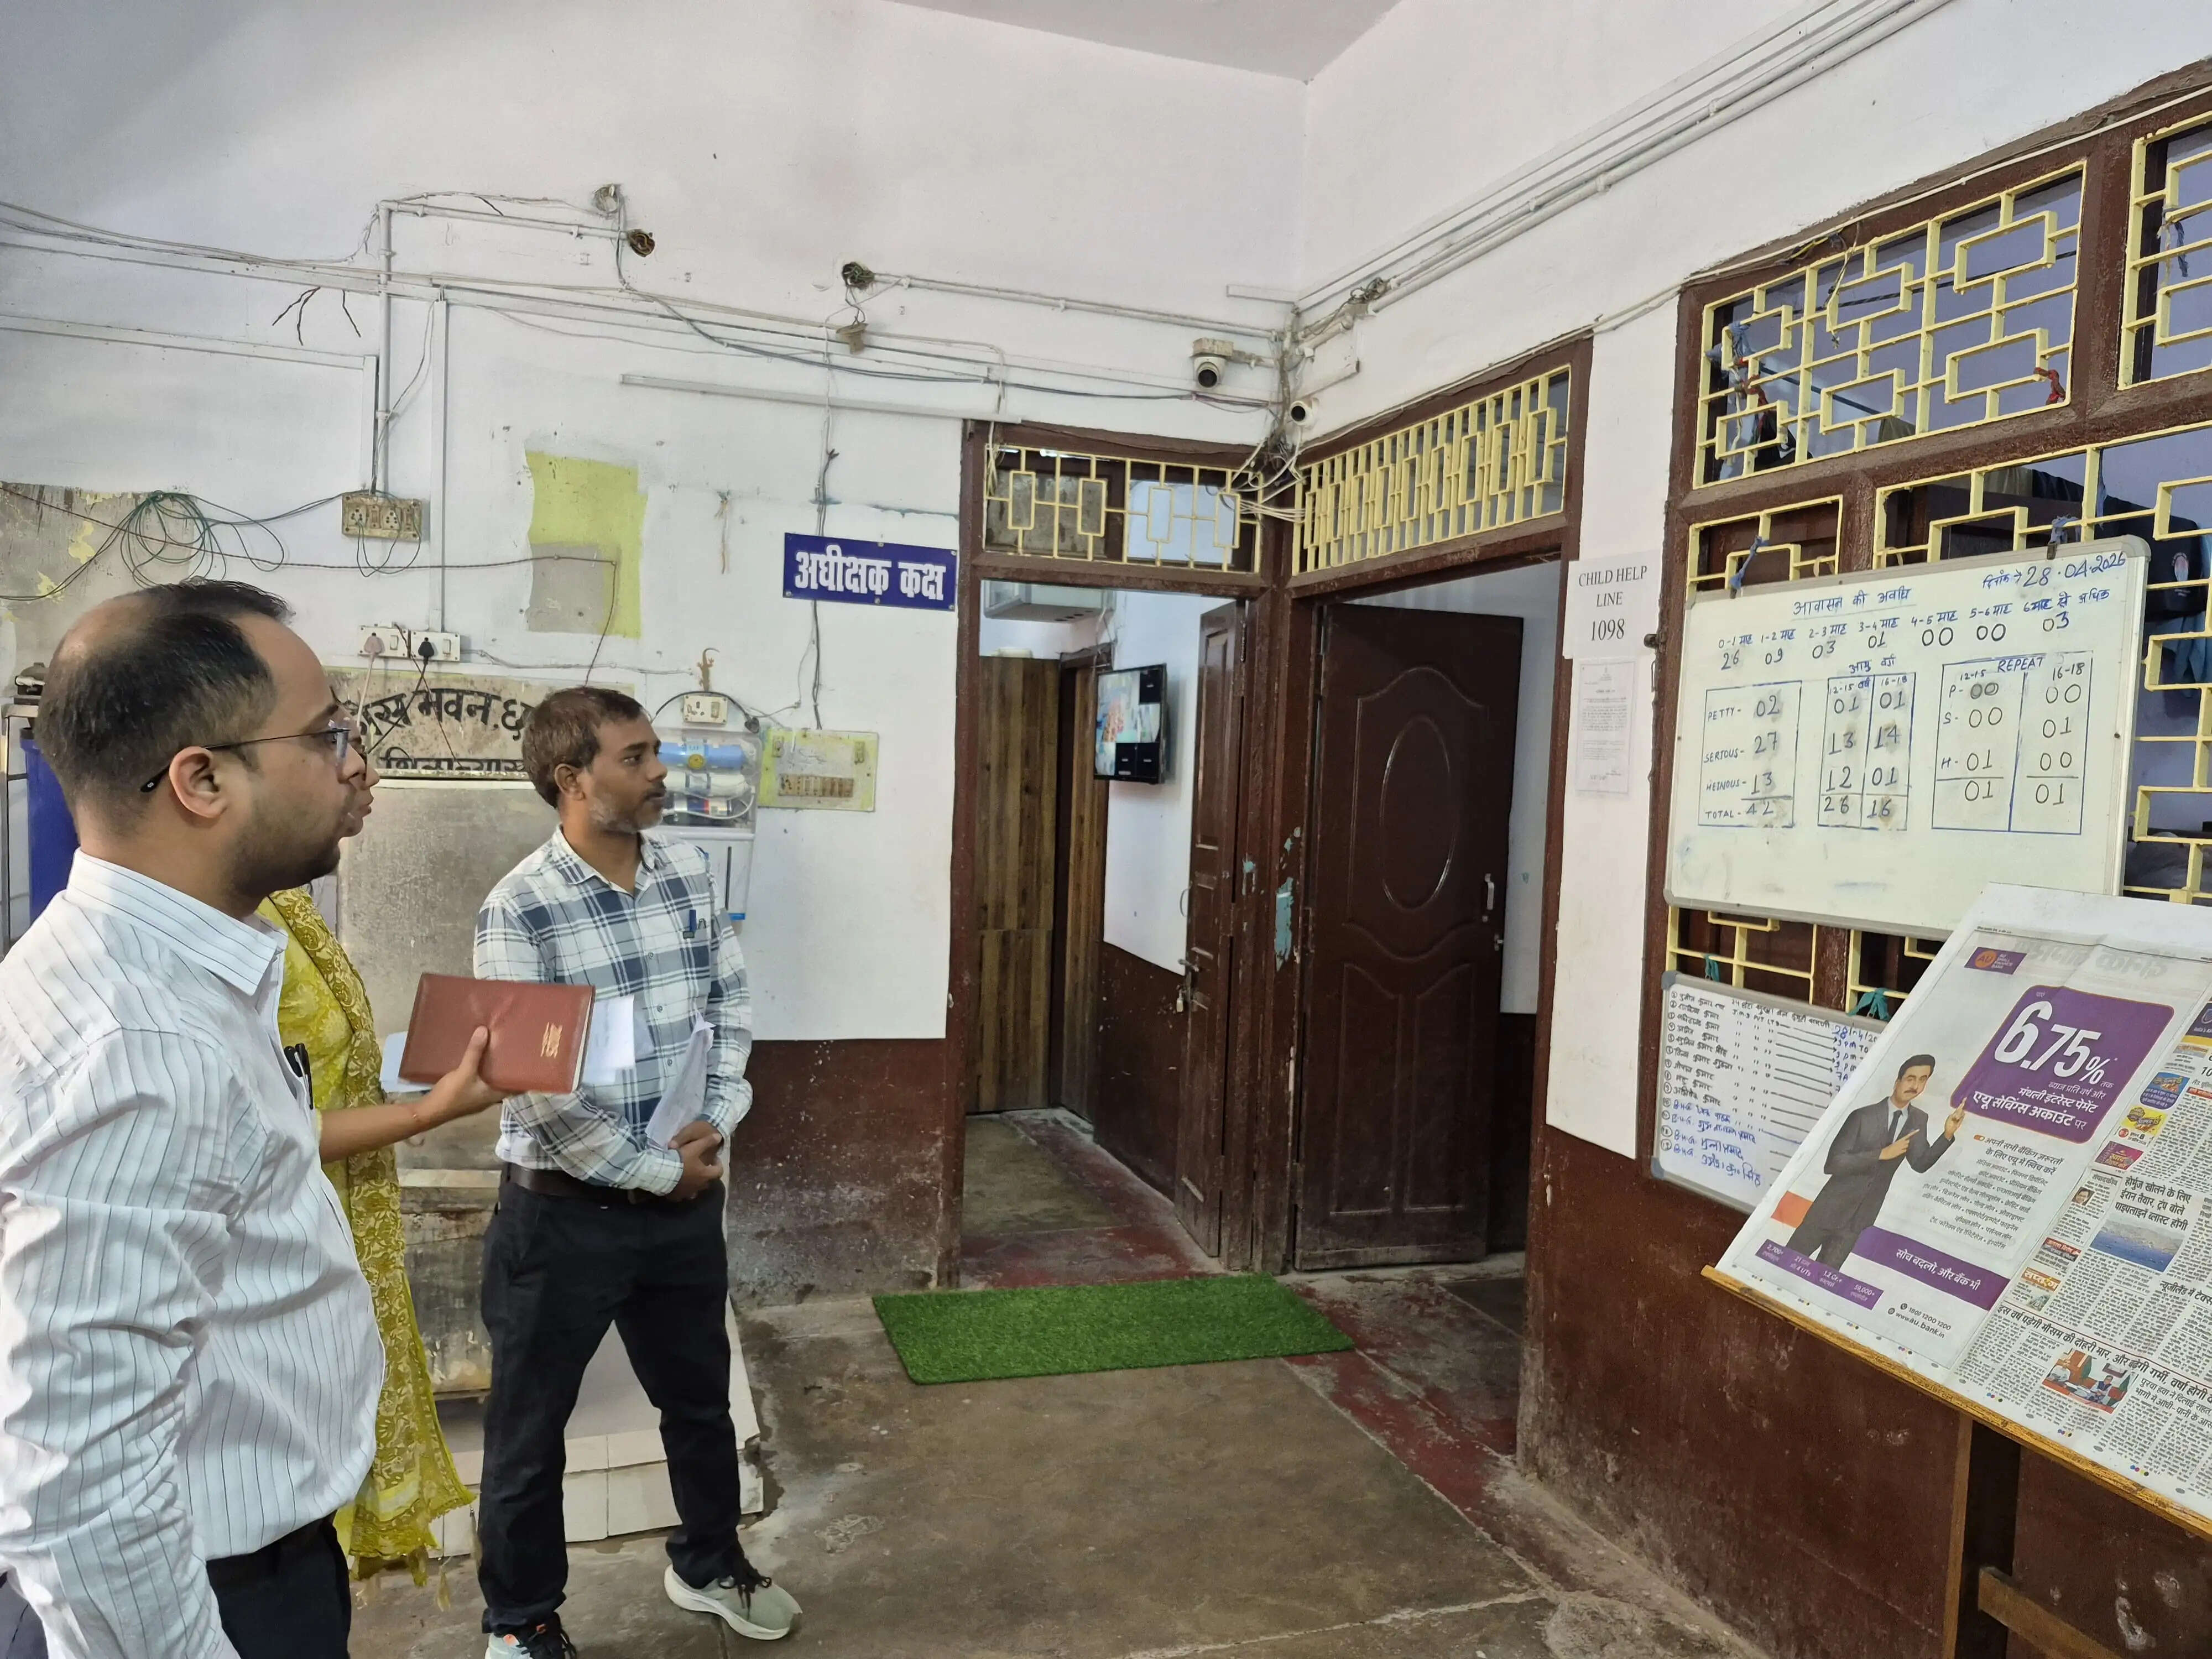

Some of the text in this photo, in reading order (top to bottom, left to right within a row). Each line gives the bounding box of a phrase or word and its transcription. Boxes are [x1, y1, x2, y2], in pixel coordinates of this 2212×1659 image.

[795, 544, 947, 601] अधीक्षक कक्ष
[1578, 566, 1647, 587] CHILD HELP
[1596, 592, 1624, 608] LINE
[1853, 592, 1867, 606] की
[1591, 618, 1625, 641] 1098
[1721, 611, 2069, 670] 26 09 03 01 00 00 03
[1997, 657, 2044, 673] REPEAT
[2053, 662, 2085, 681] 16-18
[1834, 690, 1905, 714] 01 01
[1970, 682, 1999, 699] 00
[2046, 684, 2081, 703] 00
[1756, 695, 1780, 717] 02
[1969, 707, 2002, 728] 00
[2043, 717, 2072, 738] 01
[1755, 731, 1777, 754] 27
[1829, 724, 1900, 755] 13 14
[1967, 749, 1992, 771] 01
[2040, 752, 2072, 771] 00
[1751, 772, 1772, 795] 13
[1826, 765, 1897, 792] 12 01
[1965, 780, 2064, 806] 01 01
[1746, 801, 1773, 815] 42
[1824, 795, 1892, 818] 26 16
[1973, 1091, 2088, 1130] एयू सेविंग्स अकाउंट पर
[2018, 1086, 2099, 1113] मंथली इंटरेस्ट पेमेंट
[1985, 1138, 2005, 1147] अपनी
[2004, 1142, 2019, 1152] सभी
[1985, 1147, 1994, 1155] के
[1993, 1150, 2008, 1160] लिए
[2120, 1188, 2137, 1202] ईरान
[2145, 1182, 2166, 1196] खोलने
[2167, 1187, 2176, 1198] के
[2176, 1189, 2192, 1204] लिए
[1896, 1249, 1914, 1261] सोच
[1937, 1267, 1955, 1281] और
[1969, 1279, 1981, 1291] भी
[1896, 1312, 1945, 1339] www.au.bank.in
[1908, 1307, 1952, 1331] 1800 1200 1200
[1997, 1305, 2012, 1315] इस
[2011, 1309, 2023, 1321] वर्ष
[2042, 1322, 2064, 1338] मौसम
[2063, 1332, 2075, 1343] की
[2074, 1337, 2096, 1352] दोहरी
[2112, 1354, 2131, 1366] और
[2171, 1378, 2190, 1391] वर्षा
[2187, 1385, 2208, 1400] होगी
[2156, 1386, 2170, 1396] हवा
